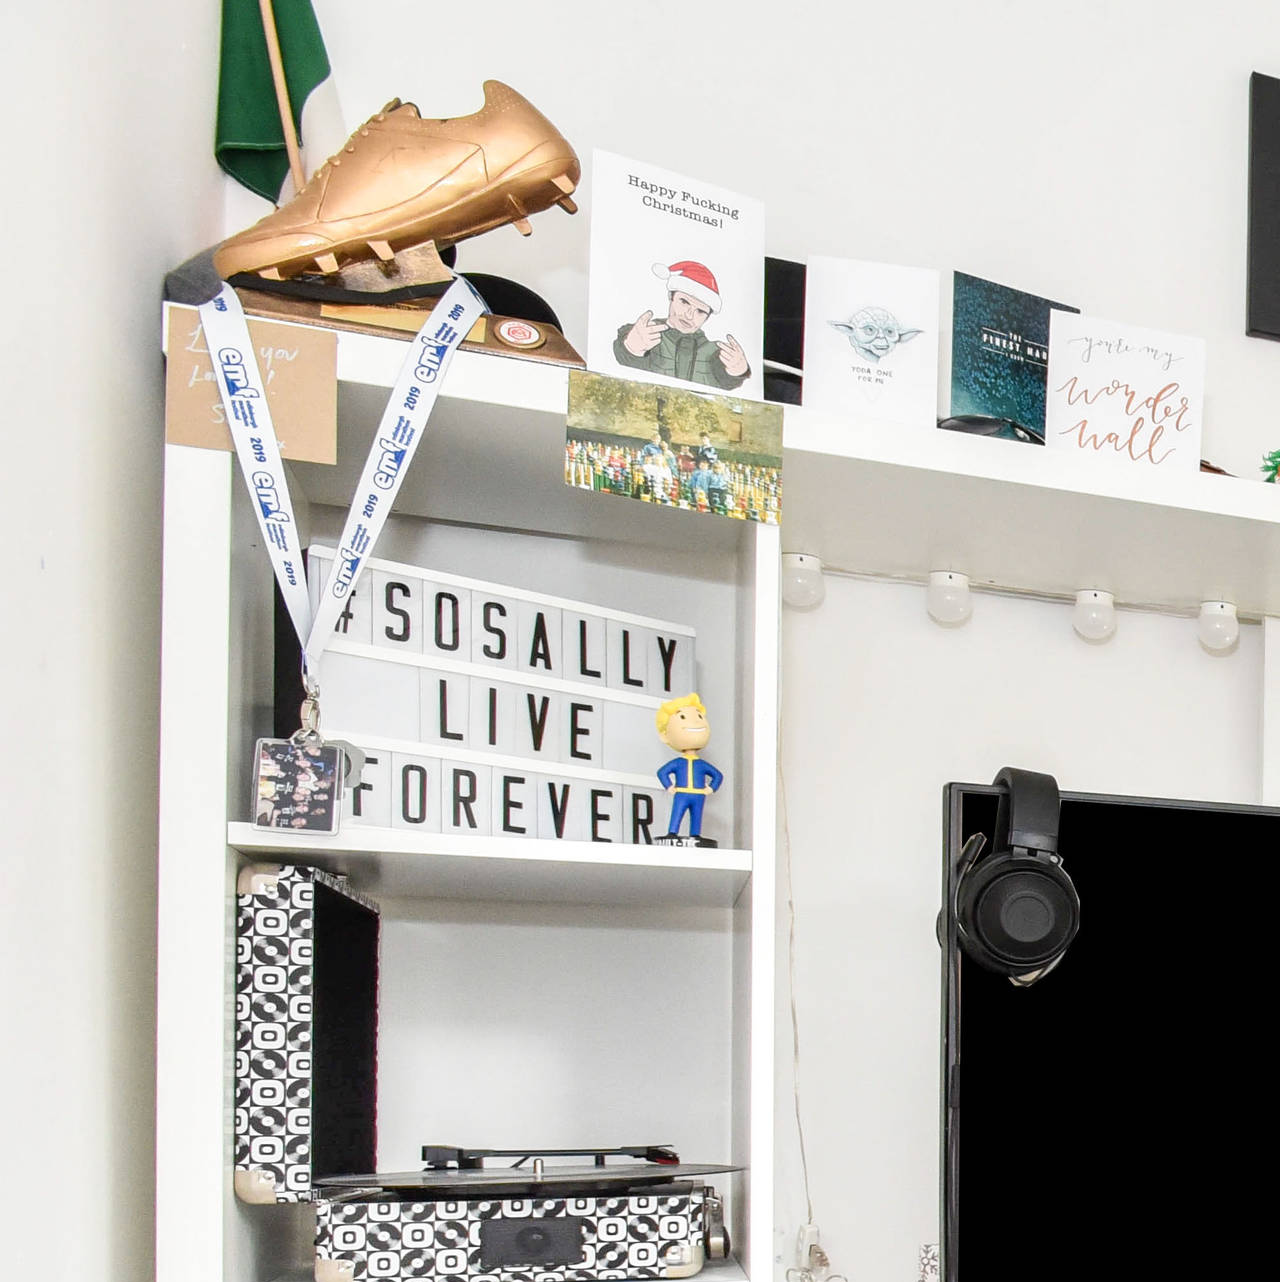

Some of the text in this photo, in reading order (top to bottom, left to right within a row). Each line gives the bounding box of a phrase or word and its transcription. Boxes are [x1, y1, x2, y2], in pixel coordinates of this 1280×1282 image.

[628, 174, 739, 220] Happy Fucking
[642, 196, 723, 228] Christmas!
[448, 303, 465, 321] 2019
[851, 366, 892, 377] YODA ONE
[404, 386, 421, 411] 2019
[1056, 376, 1192, 432] wonder
[250, 437, 266, 463] 2019
[1059, 416, 1176, 464] wall
[363, 494, 379, 519] 2019
[283, 560, 297, 586] 2019
[440, 679, 593, 760] LIVE
[353, 756, 654, 845] FOREVER
